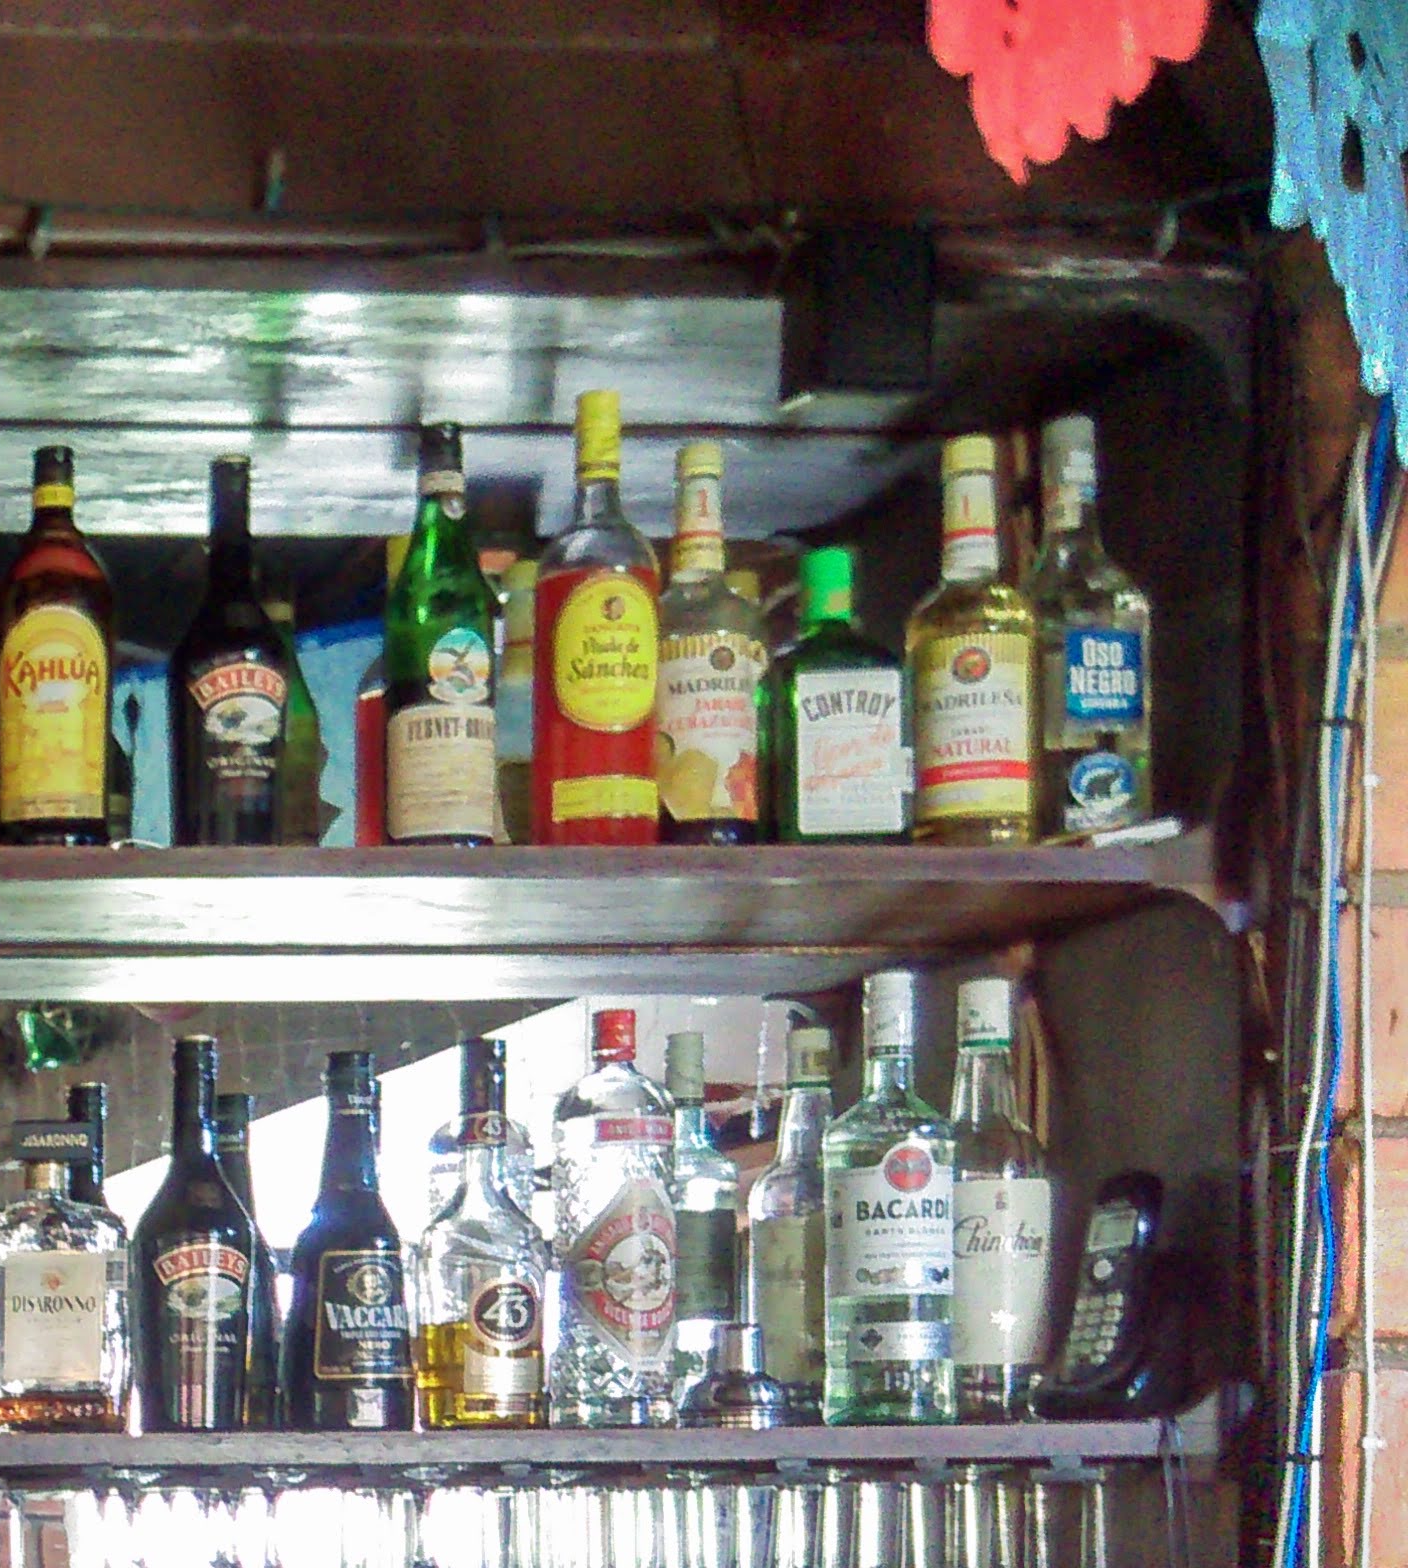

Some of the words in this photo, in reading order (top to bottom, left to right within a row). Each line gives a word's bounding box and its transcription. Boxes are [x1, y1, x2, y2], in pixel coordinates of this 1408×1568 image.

[1082, 637, 1124, 667] OSO
[2, 650, 101, 698] KAHLÚA
[1070, 665, 1137, 696] NEGRO
[801, 689, 896, 722] CONTROY
[952, 1215, 1044, 1259] Chinhón
[161, 1248, 245, 1275] BAILEYS
[11, 1295, 96, 1314] DISARONNO
[324, 1301, 408, 1331] VACCAR
[482, 1294, 529, 1328] 43
